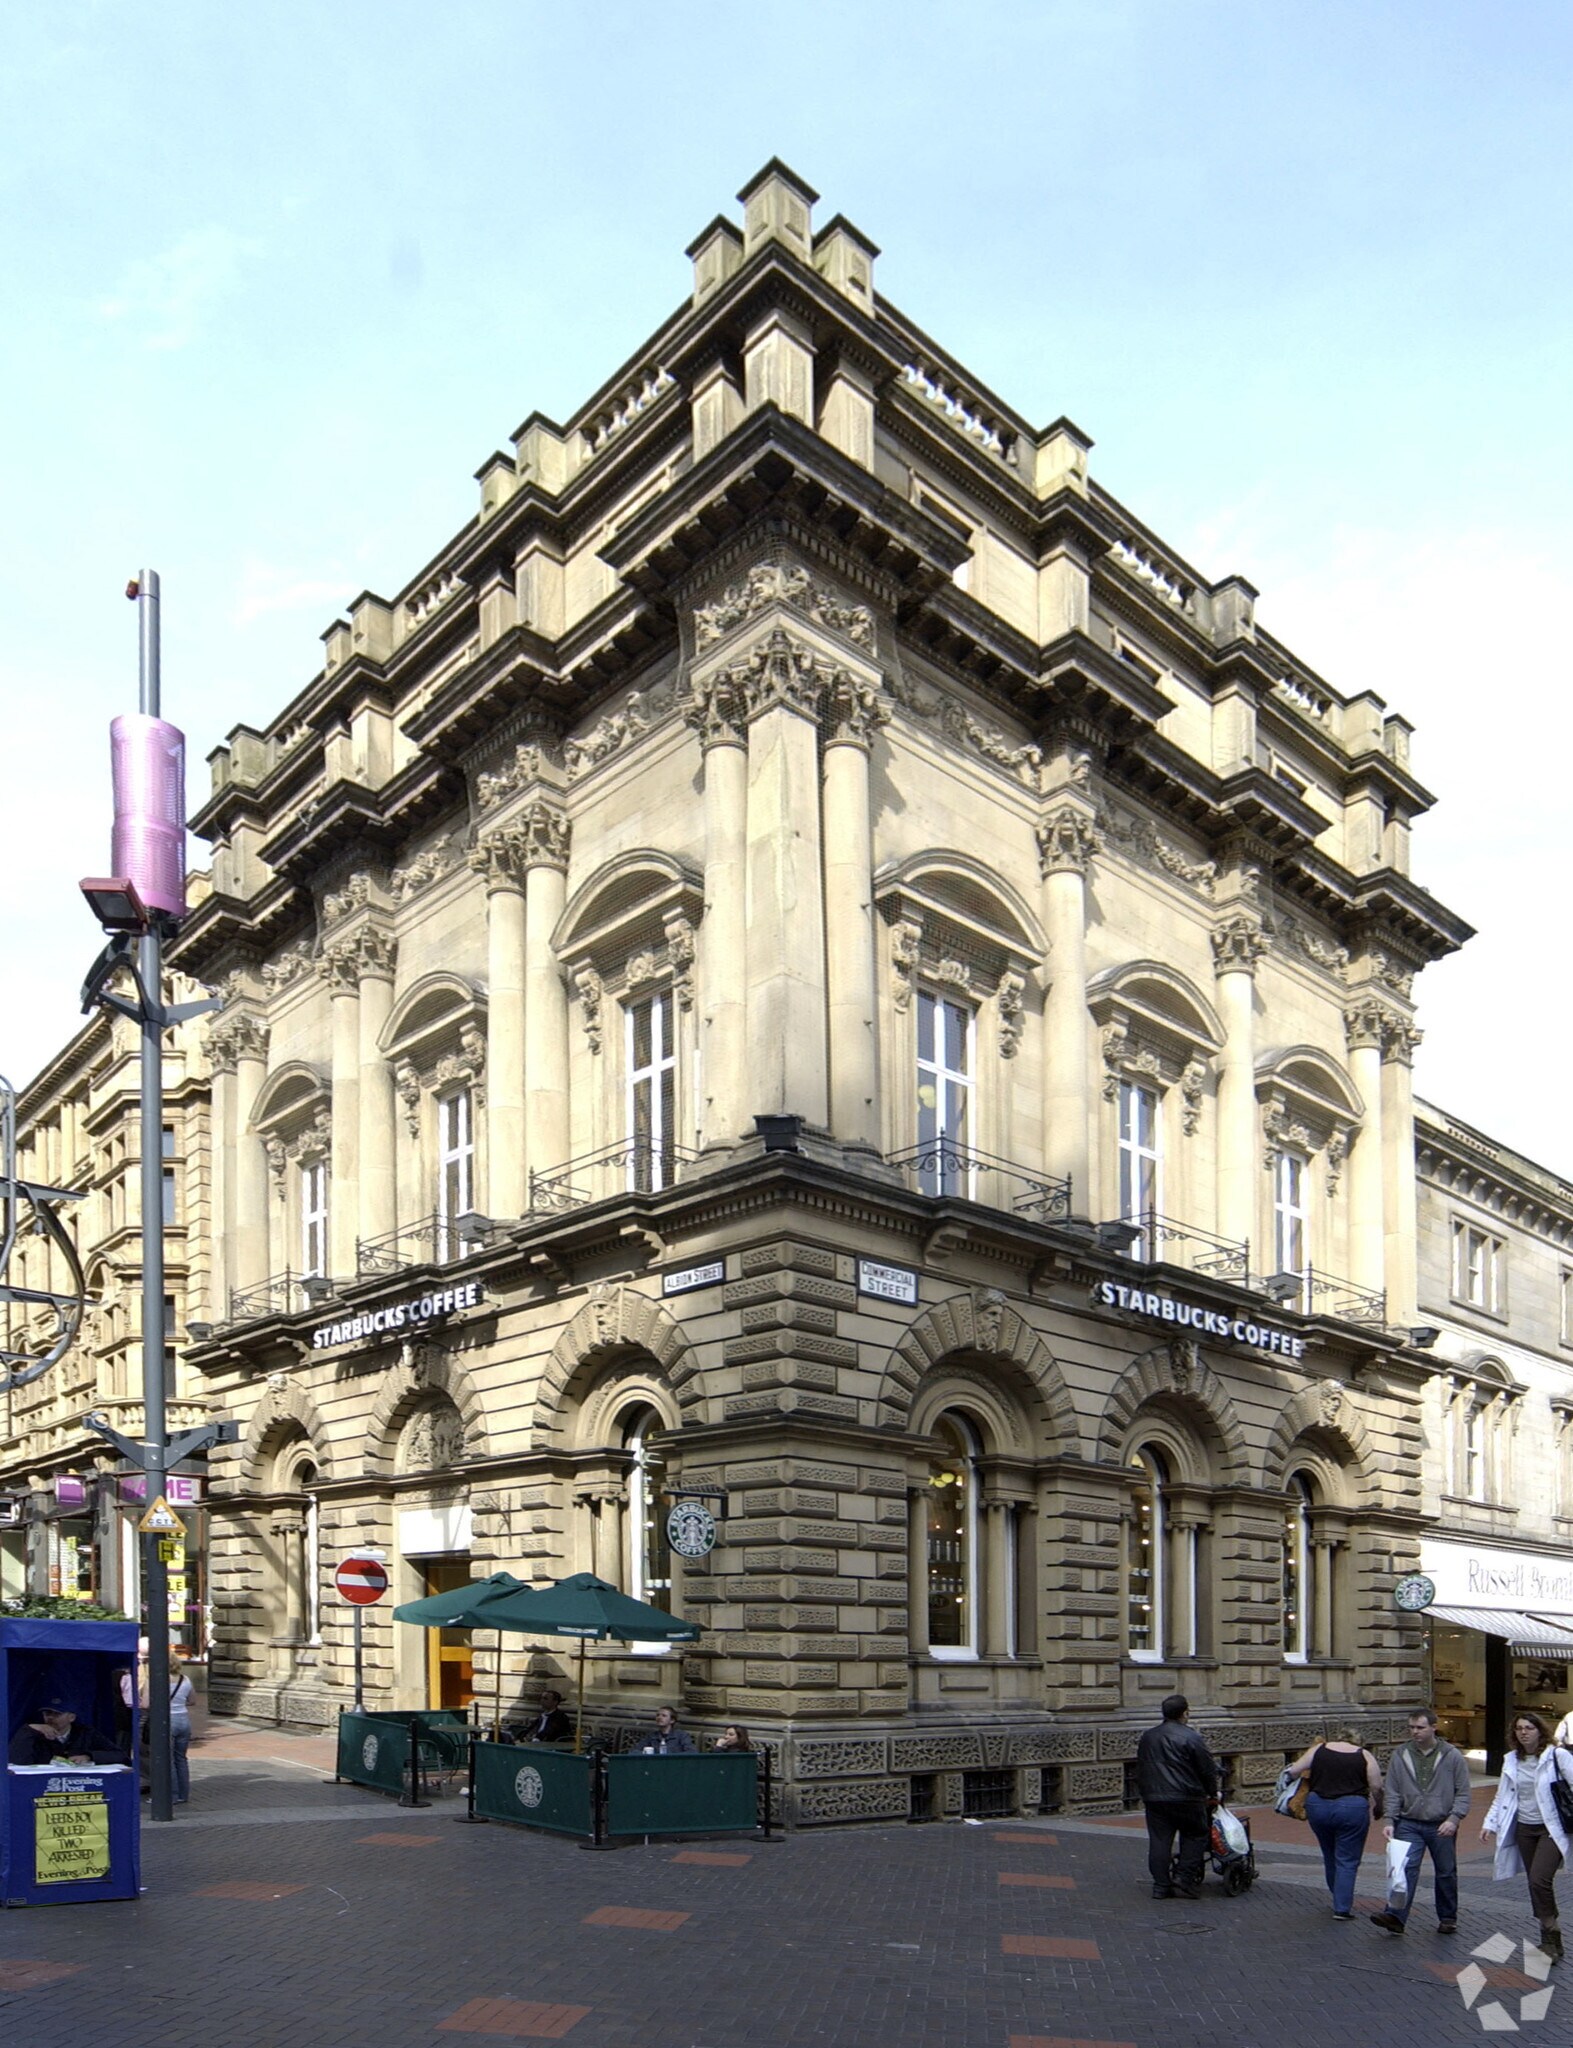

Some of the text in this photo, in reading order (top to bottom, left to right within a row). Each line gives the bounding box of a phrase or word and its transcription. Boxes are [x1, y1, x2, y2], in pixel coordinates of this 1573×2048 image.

[667, 1264, 723, 1288] ALBION STREET
[862, 1261, 914, 1287] COMMERCIAL
[868, 1277, 908, 1298] STREET
[313, 1283, 478, 1349] STARBUCKS COFFEE
[1101, 1281, 1302, 1358] STARBUCKS COFFEE
[670, 1504, 714, 1531] STARBUCKS
[161, 1542, 174, 1560] H
[675, 1539, 709, 1555] COFFEE
[1468, 1558, 1524, 1597] Russell
[62, 1777, 104, 1787] Evening
[62, 1784, 85, 1792] Post
[46, 1811, 92, 1825] LEEDS BOY
[57, 1838, 83, 1849] TWO
[48, 1849, 95, 1863] ARRESTED
[38, 1868, 79, 1880] Evening
